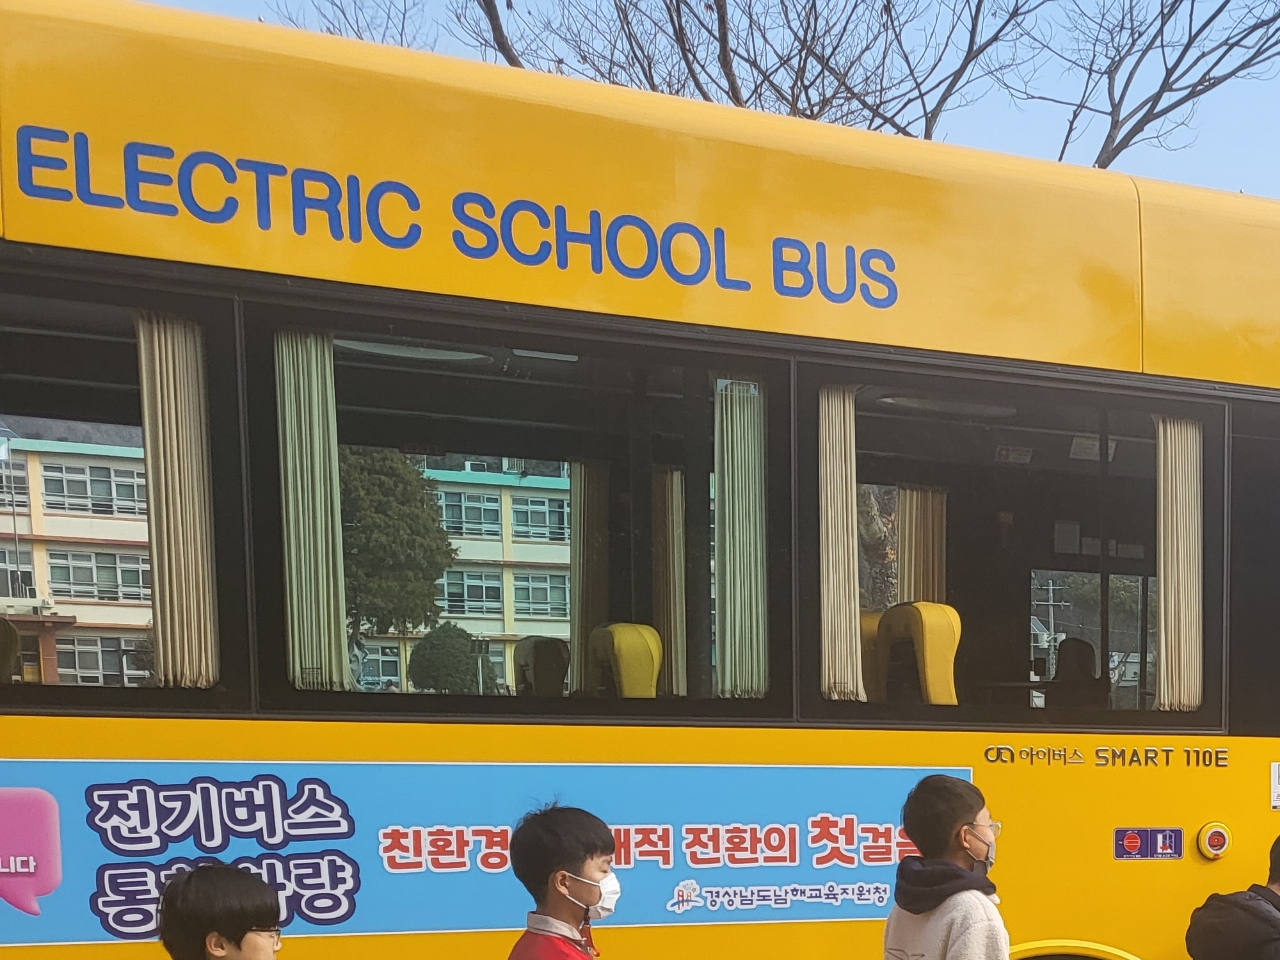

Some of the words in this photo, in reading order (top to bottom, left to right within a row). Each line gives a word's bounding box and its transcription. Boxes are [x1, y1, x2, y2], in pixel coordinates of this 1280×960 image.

[16, 124, 421, 249] ELECTRIC
[451, 191, 751, 293] SCHOOL
[772, 236, 898, 310] BUS
[1019, 745, 1085, 766] 아이버스
[1095, 746, 1175, 767] SMART
[1183, 747, 1230, 768] 110E
[87, 776, 355, 856] 전기버스
[379, 824, 513, 874] 친환경
[681, 824, 799, 869] 전환의
[703, 883, 889, 909] 경상남도남해교육지원청
